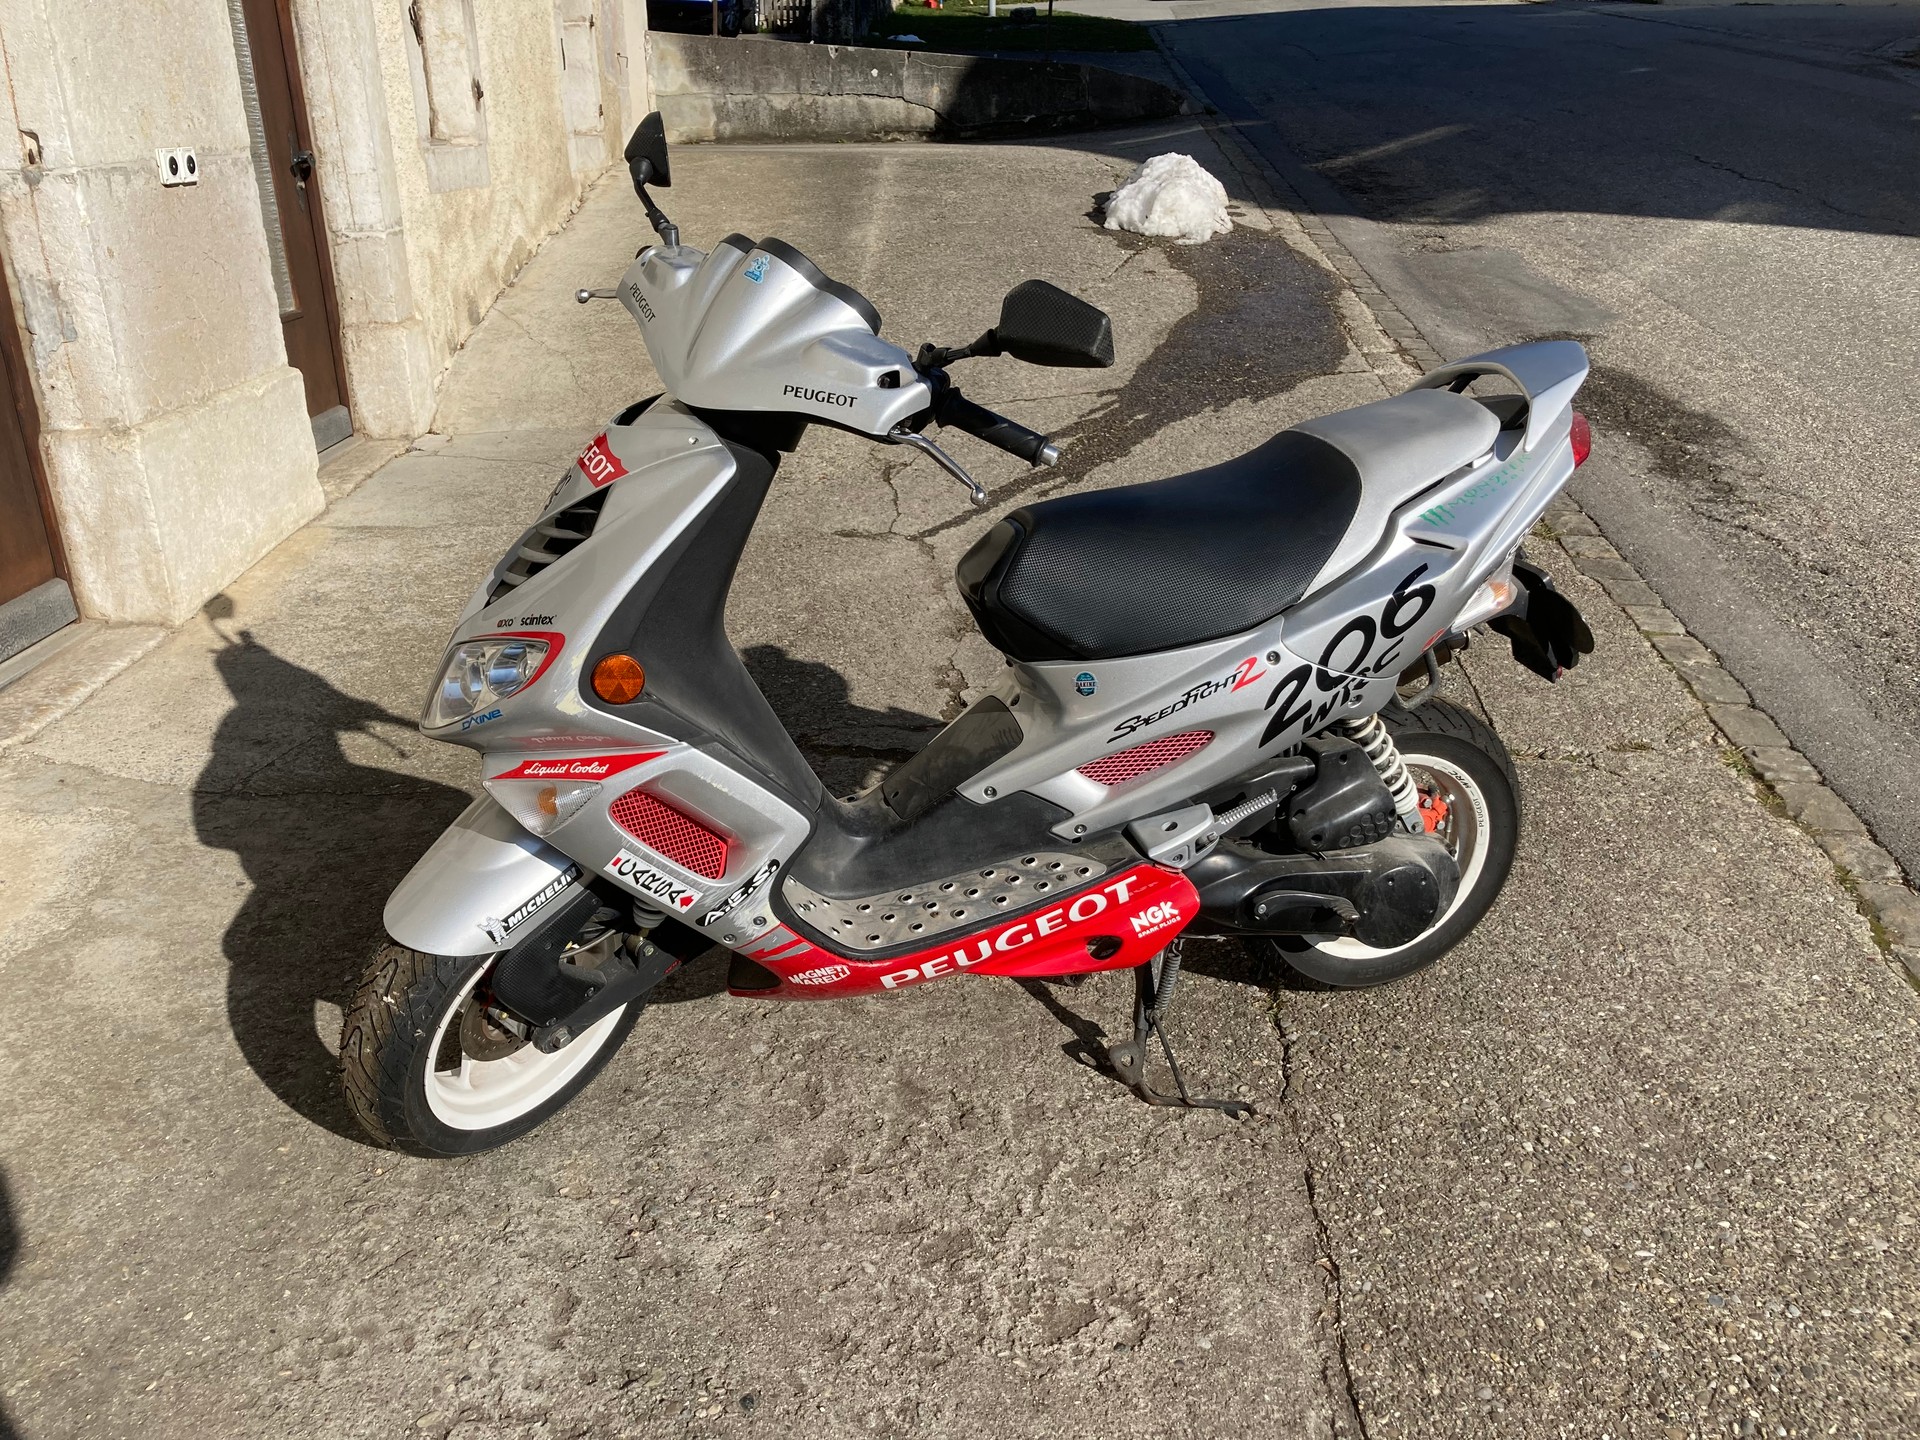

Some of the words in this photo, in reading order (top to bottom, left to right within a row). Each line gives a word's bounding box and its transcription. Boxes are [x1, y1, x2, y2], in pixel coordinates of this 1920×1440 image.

[629, 282, 656, 323] PEUGEOT
[783, 384, 858, 408] PEUGEOT
[520, 614, 554, 626] scintex
[1258, 562, 1436, 749] 206
[524, 762, 569, 776] Liquid
[570, 761, 610, 774] Cooled
[1447, 770, 1472, 789] WRC
[1473, 798, 1485, 828] PEUGEOT
[508, 865, 578, 929] MICHELIN
[617, 858, 688, 905] CARSA
[880, 874, 1138, 990] PEUGEOT
[1129, 901, 1179, 933] NGK
[1137, 926, 1159, 939] SPARK
[1159, 915, 1181, 929] PLUGS
